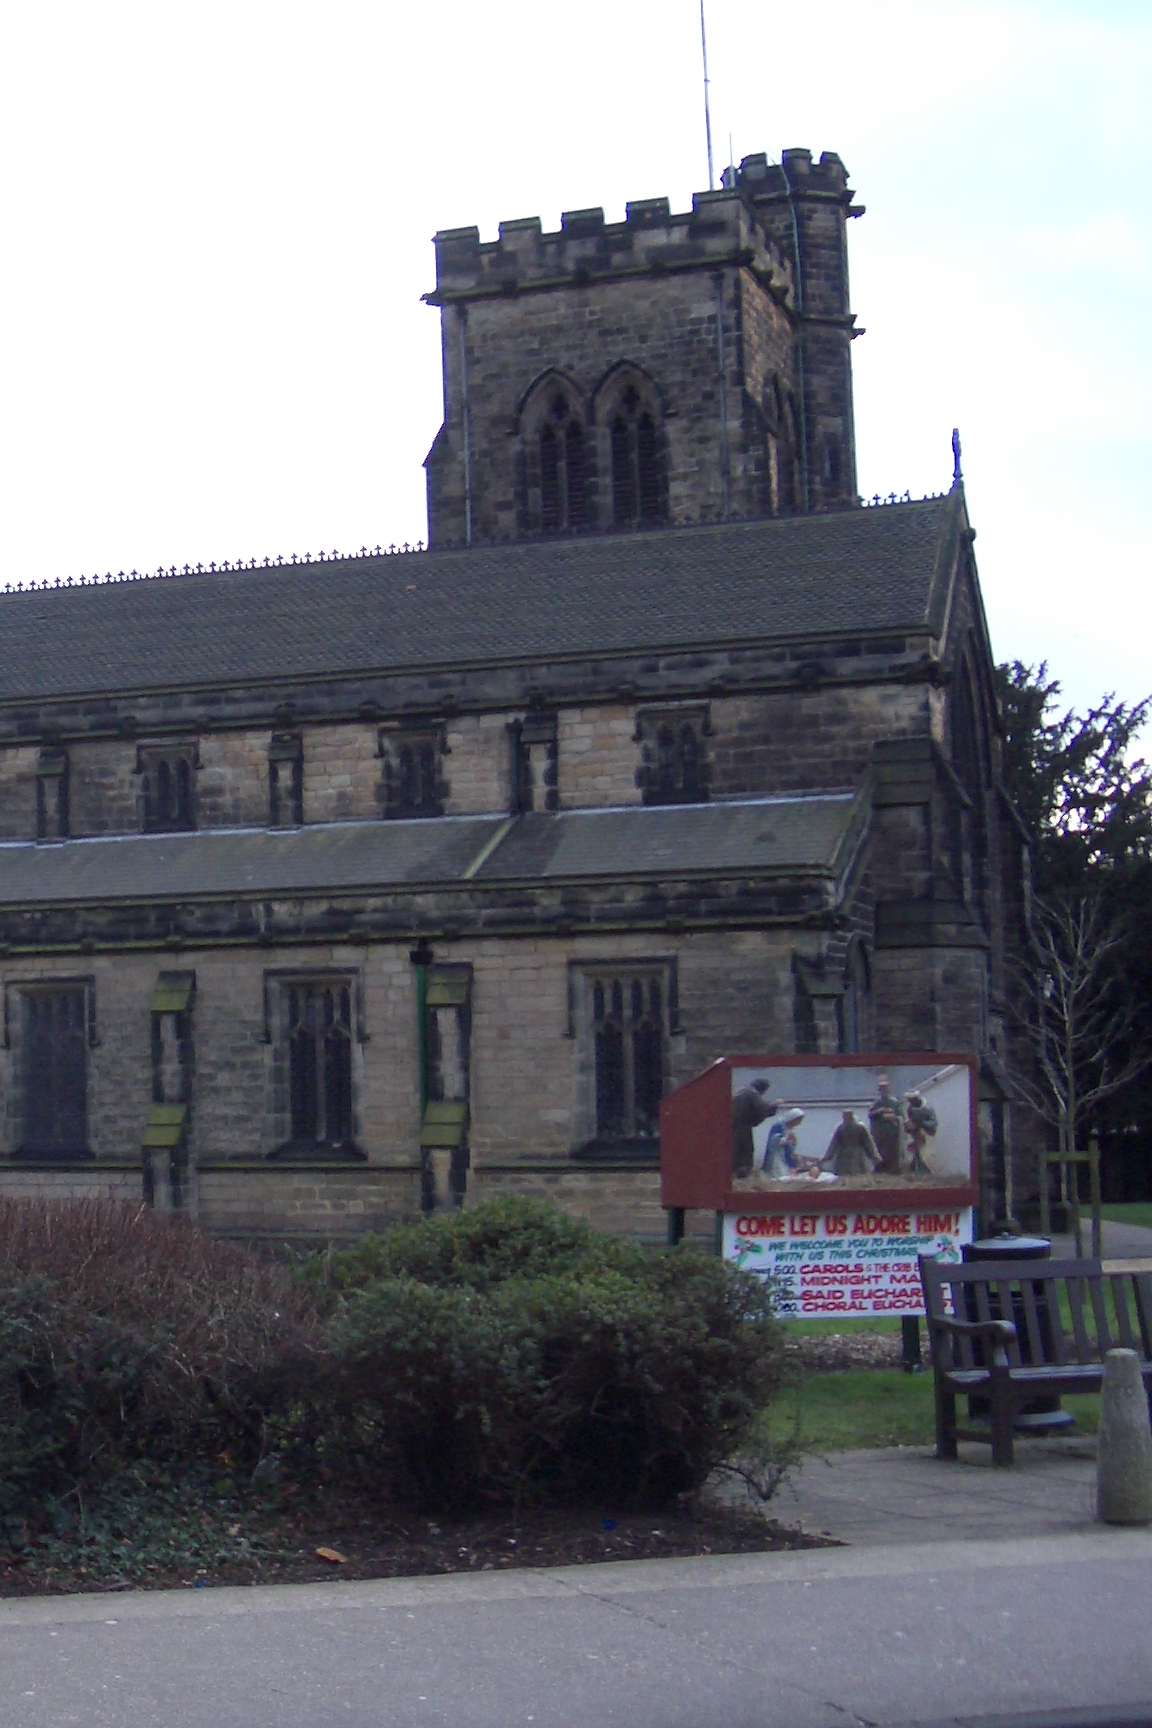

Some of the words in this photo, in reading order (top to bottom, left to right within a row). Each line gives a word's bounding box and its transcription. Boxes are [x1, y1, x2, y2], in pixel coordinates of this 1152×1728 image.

[735, 1215, 785, 1236] COME
[789, 1215, 820, 1236] LET
[824, 1214, 847, 1235] US
[851, 1214, 911, 1235] ADORE
[915, 1213, 960, 1236] HIM!
[768, 1241, 786, 1252] WE
[789, 1239, 843, 1250] WELCOME
[847, 1237, 869, 1248] YOU
[871, 1237, 884, 1246] TO
[887, 1235, 935, 1246] WORSHIP
[775, 1252, 804, 1262] WITH
[807, 1251, 825, 1260] US
[829, 1250, 852, 1259] THIS
[856, 1247, 918, 1259] CHRISTMAS
[799, 1263, 864, 1275] CAROLS
[874, 1263, 890, 1272] THE
[800, 1275, 882, 1287] MIDNIGHT
[889, 1274, 923, 1284] MA
[801, 1289, 845, 1301] SAID
[801, 1301, 867, 1312] CHORAL
